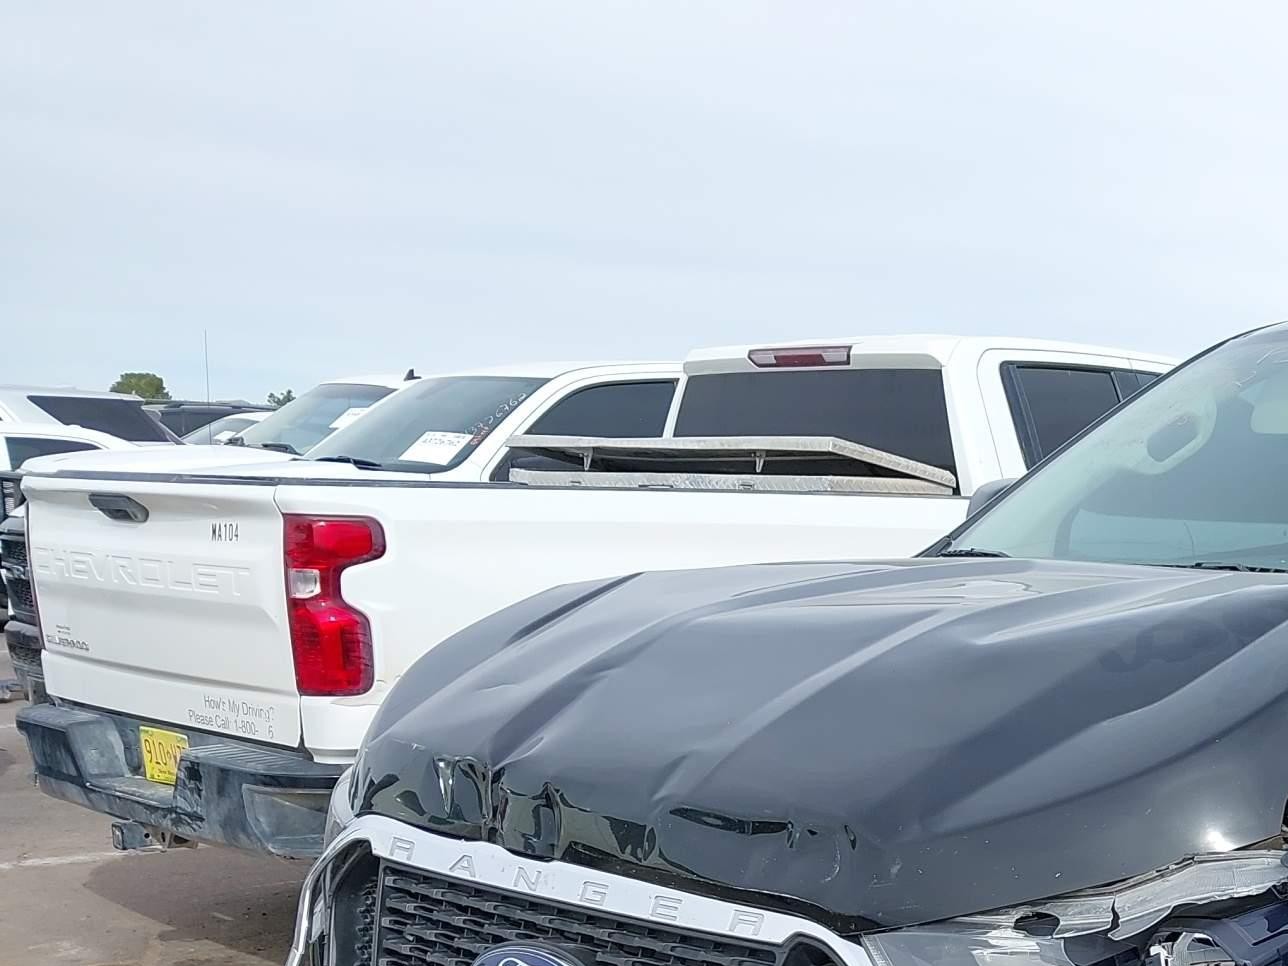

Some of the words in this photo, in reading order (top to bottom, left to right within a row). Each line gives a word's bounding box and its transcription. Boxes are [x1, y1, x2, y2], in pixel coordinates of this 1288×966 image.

[34, 546, 250, 596] CHEVROLET
[187, 709, 214, 726] Please
[203, 695, 226, 711] How's
[228, 699, 240, 717] My
[242, 701, 274, 723] Driving?
[389, 835, 765, 936] RANGER
